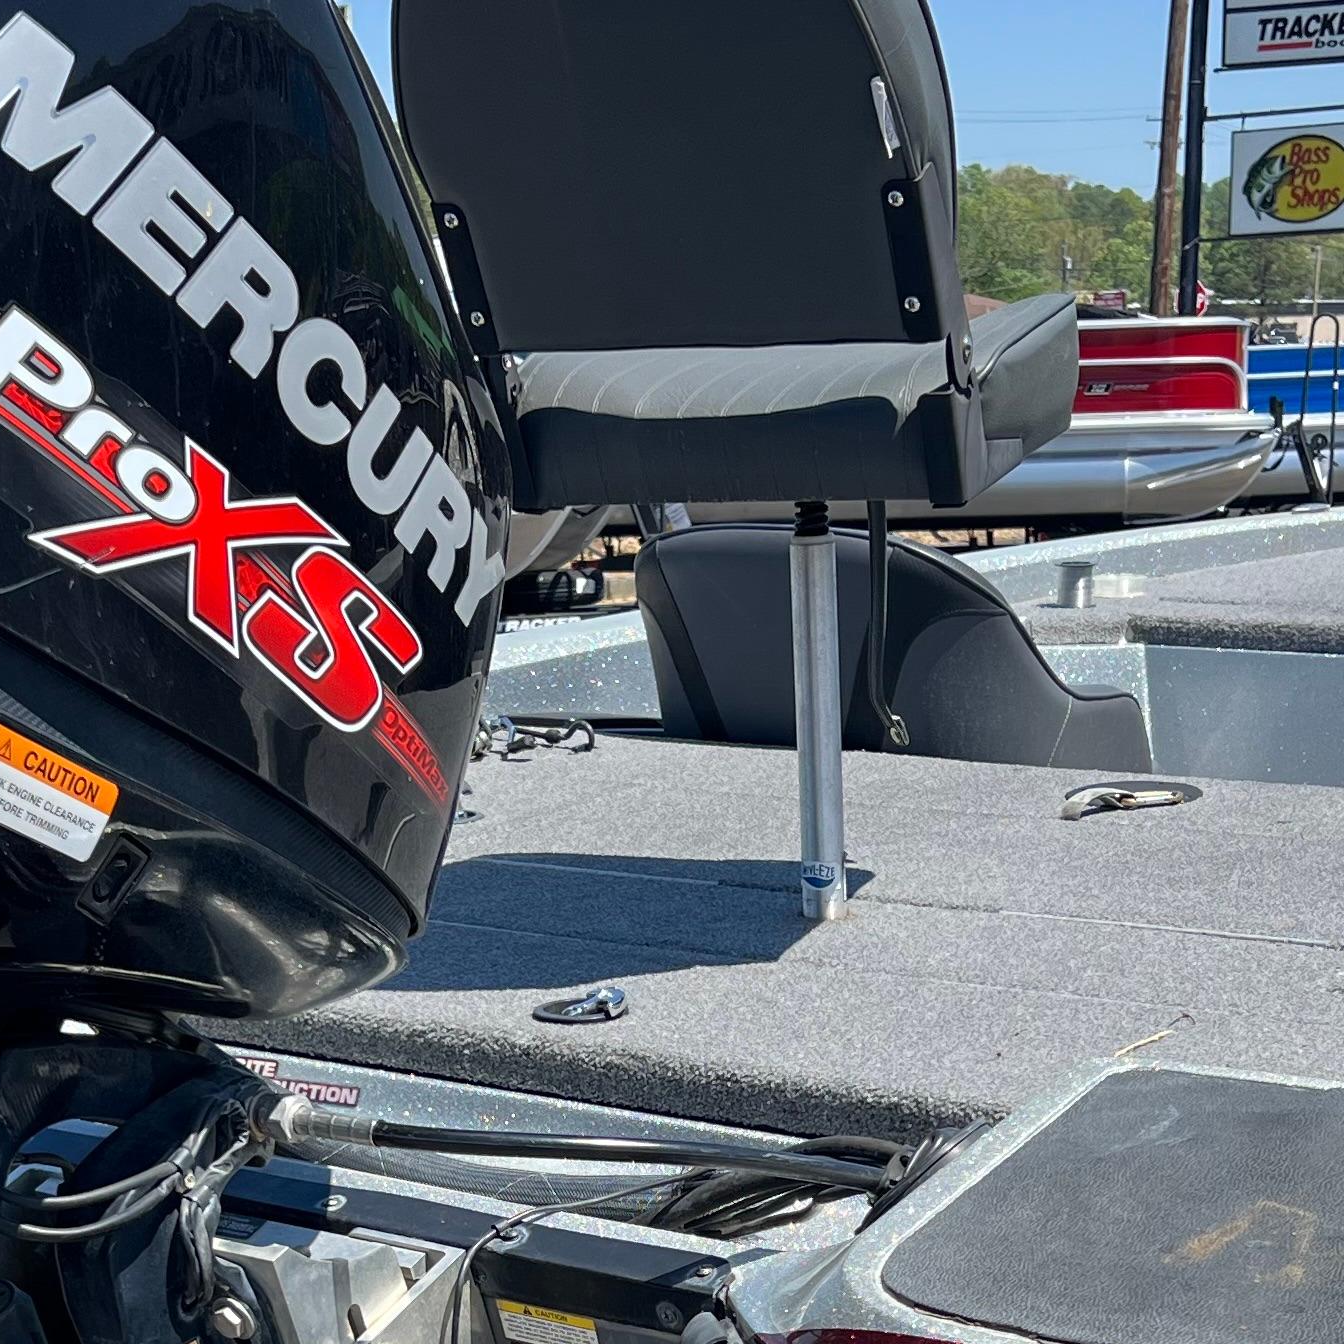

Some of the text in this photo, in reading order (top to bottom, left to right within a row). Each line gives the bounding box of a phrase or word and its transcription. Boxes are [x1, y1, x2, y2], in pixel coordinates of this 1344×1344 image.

[1289, 143, 1330, 165] Bass
[1290, 166, 1320, 186] Pro
[1287, 185, 1340, 212] Shops
[381, 704, 450, 797] OptiMax
[24, 751, 100, 803] CAUTION
[7, 783, 44, 808] ENGINE
[43, 801, 97, 834] CLEARANCE
[25, 811, 70, 840] TRIMMING
